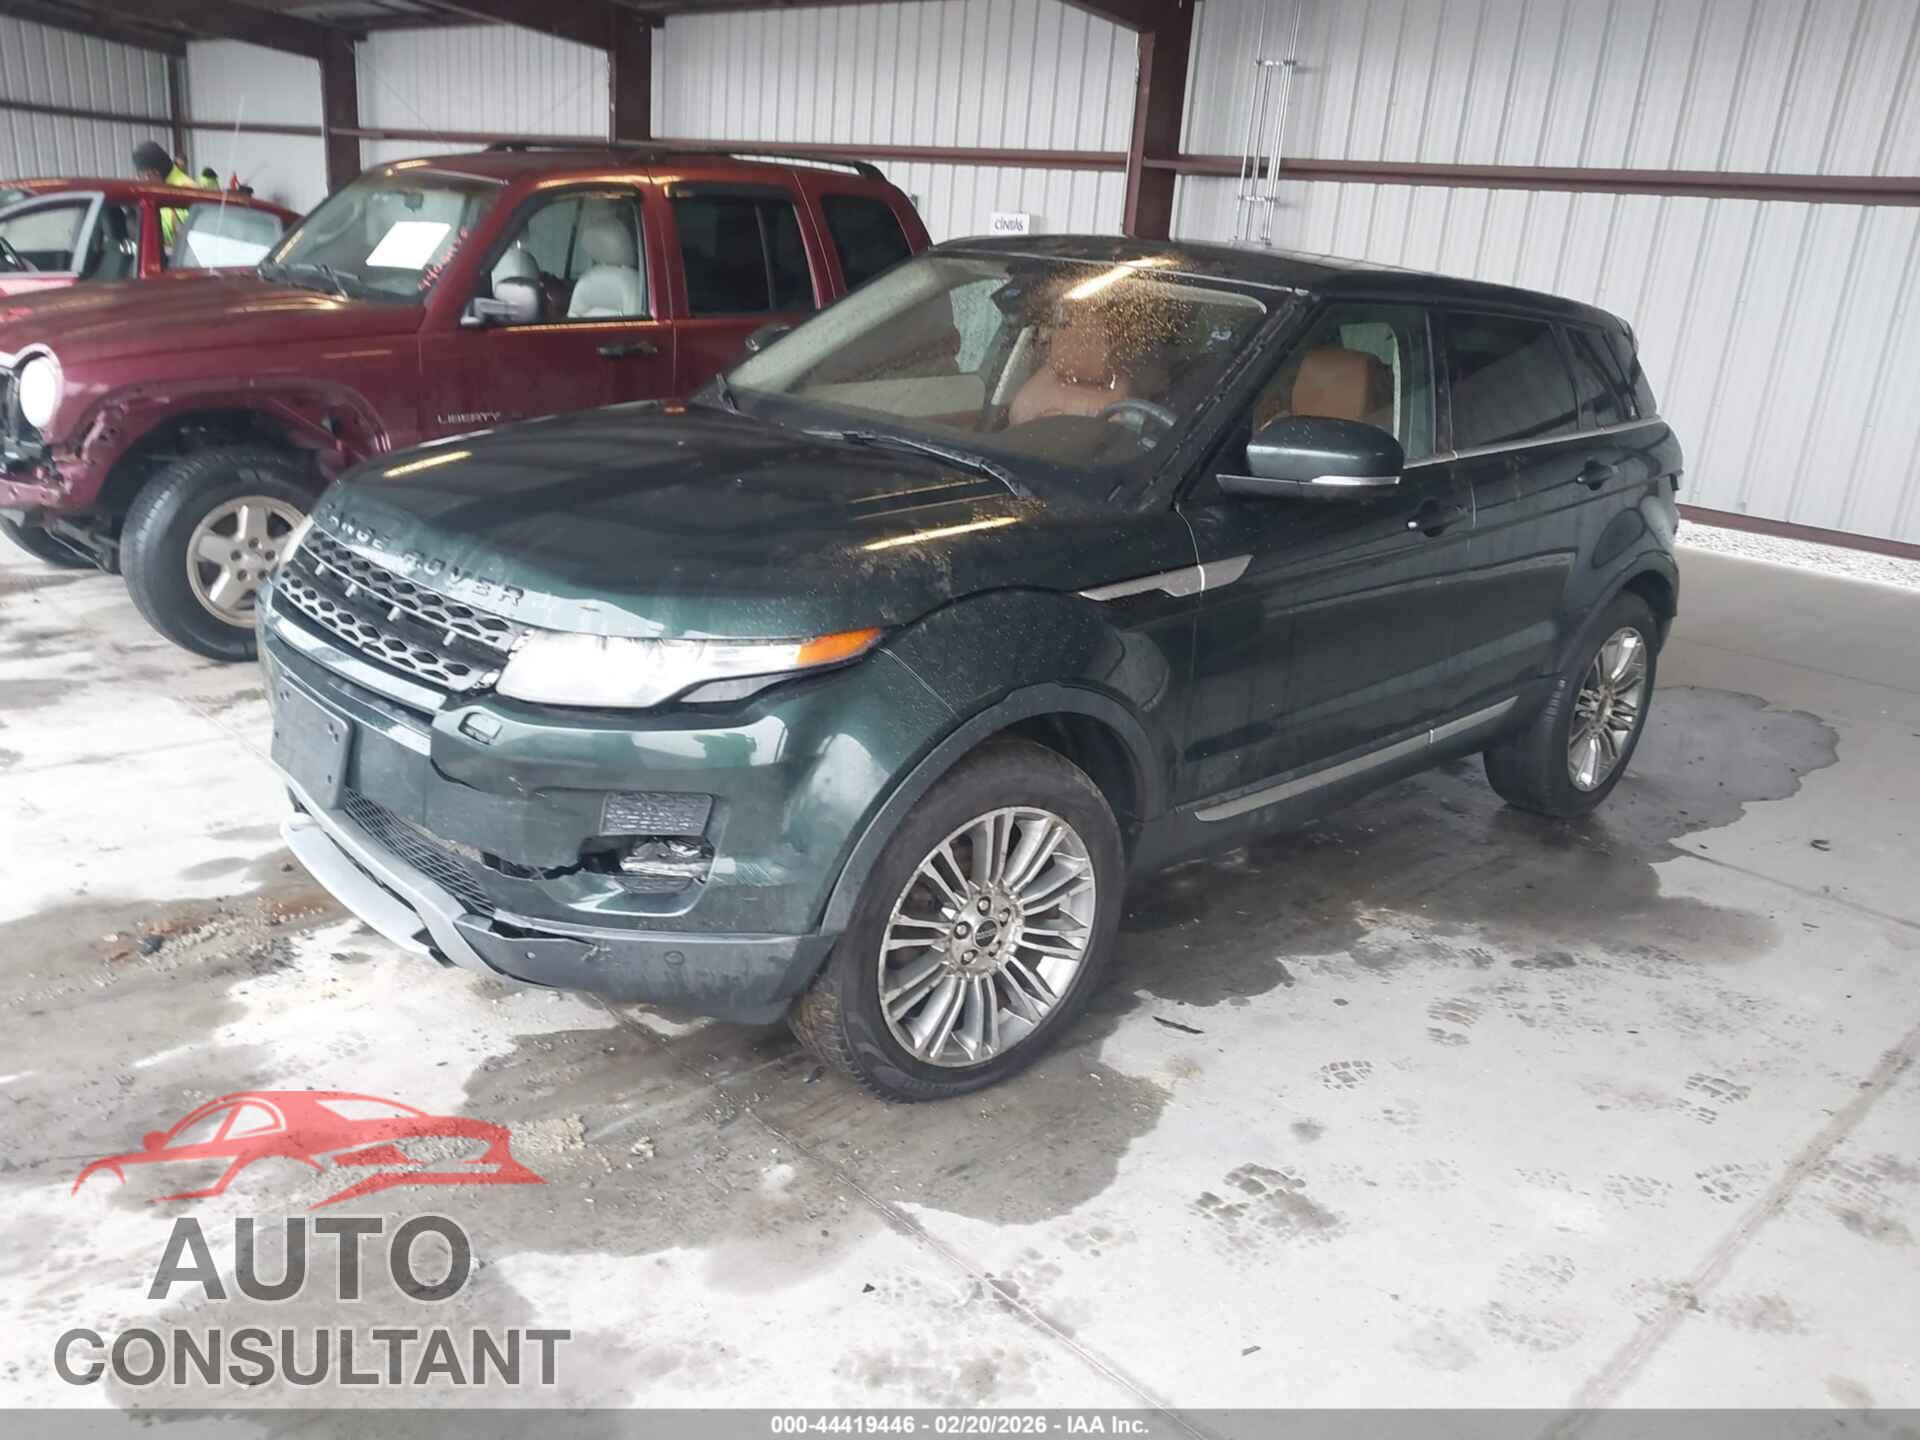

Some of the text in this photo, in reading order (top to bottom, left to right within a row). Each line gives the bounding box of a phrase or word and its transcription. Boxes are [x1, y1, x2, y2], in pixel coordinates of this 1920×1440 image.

[437, 411, 501, 424] LIBERTY
[322, 503, 525, 607] ANGE ROVER
